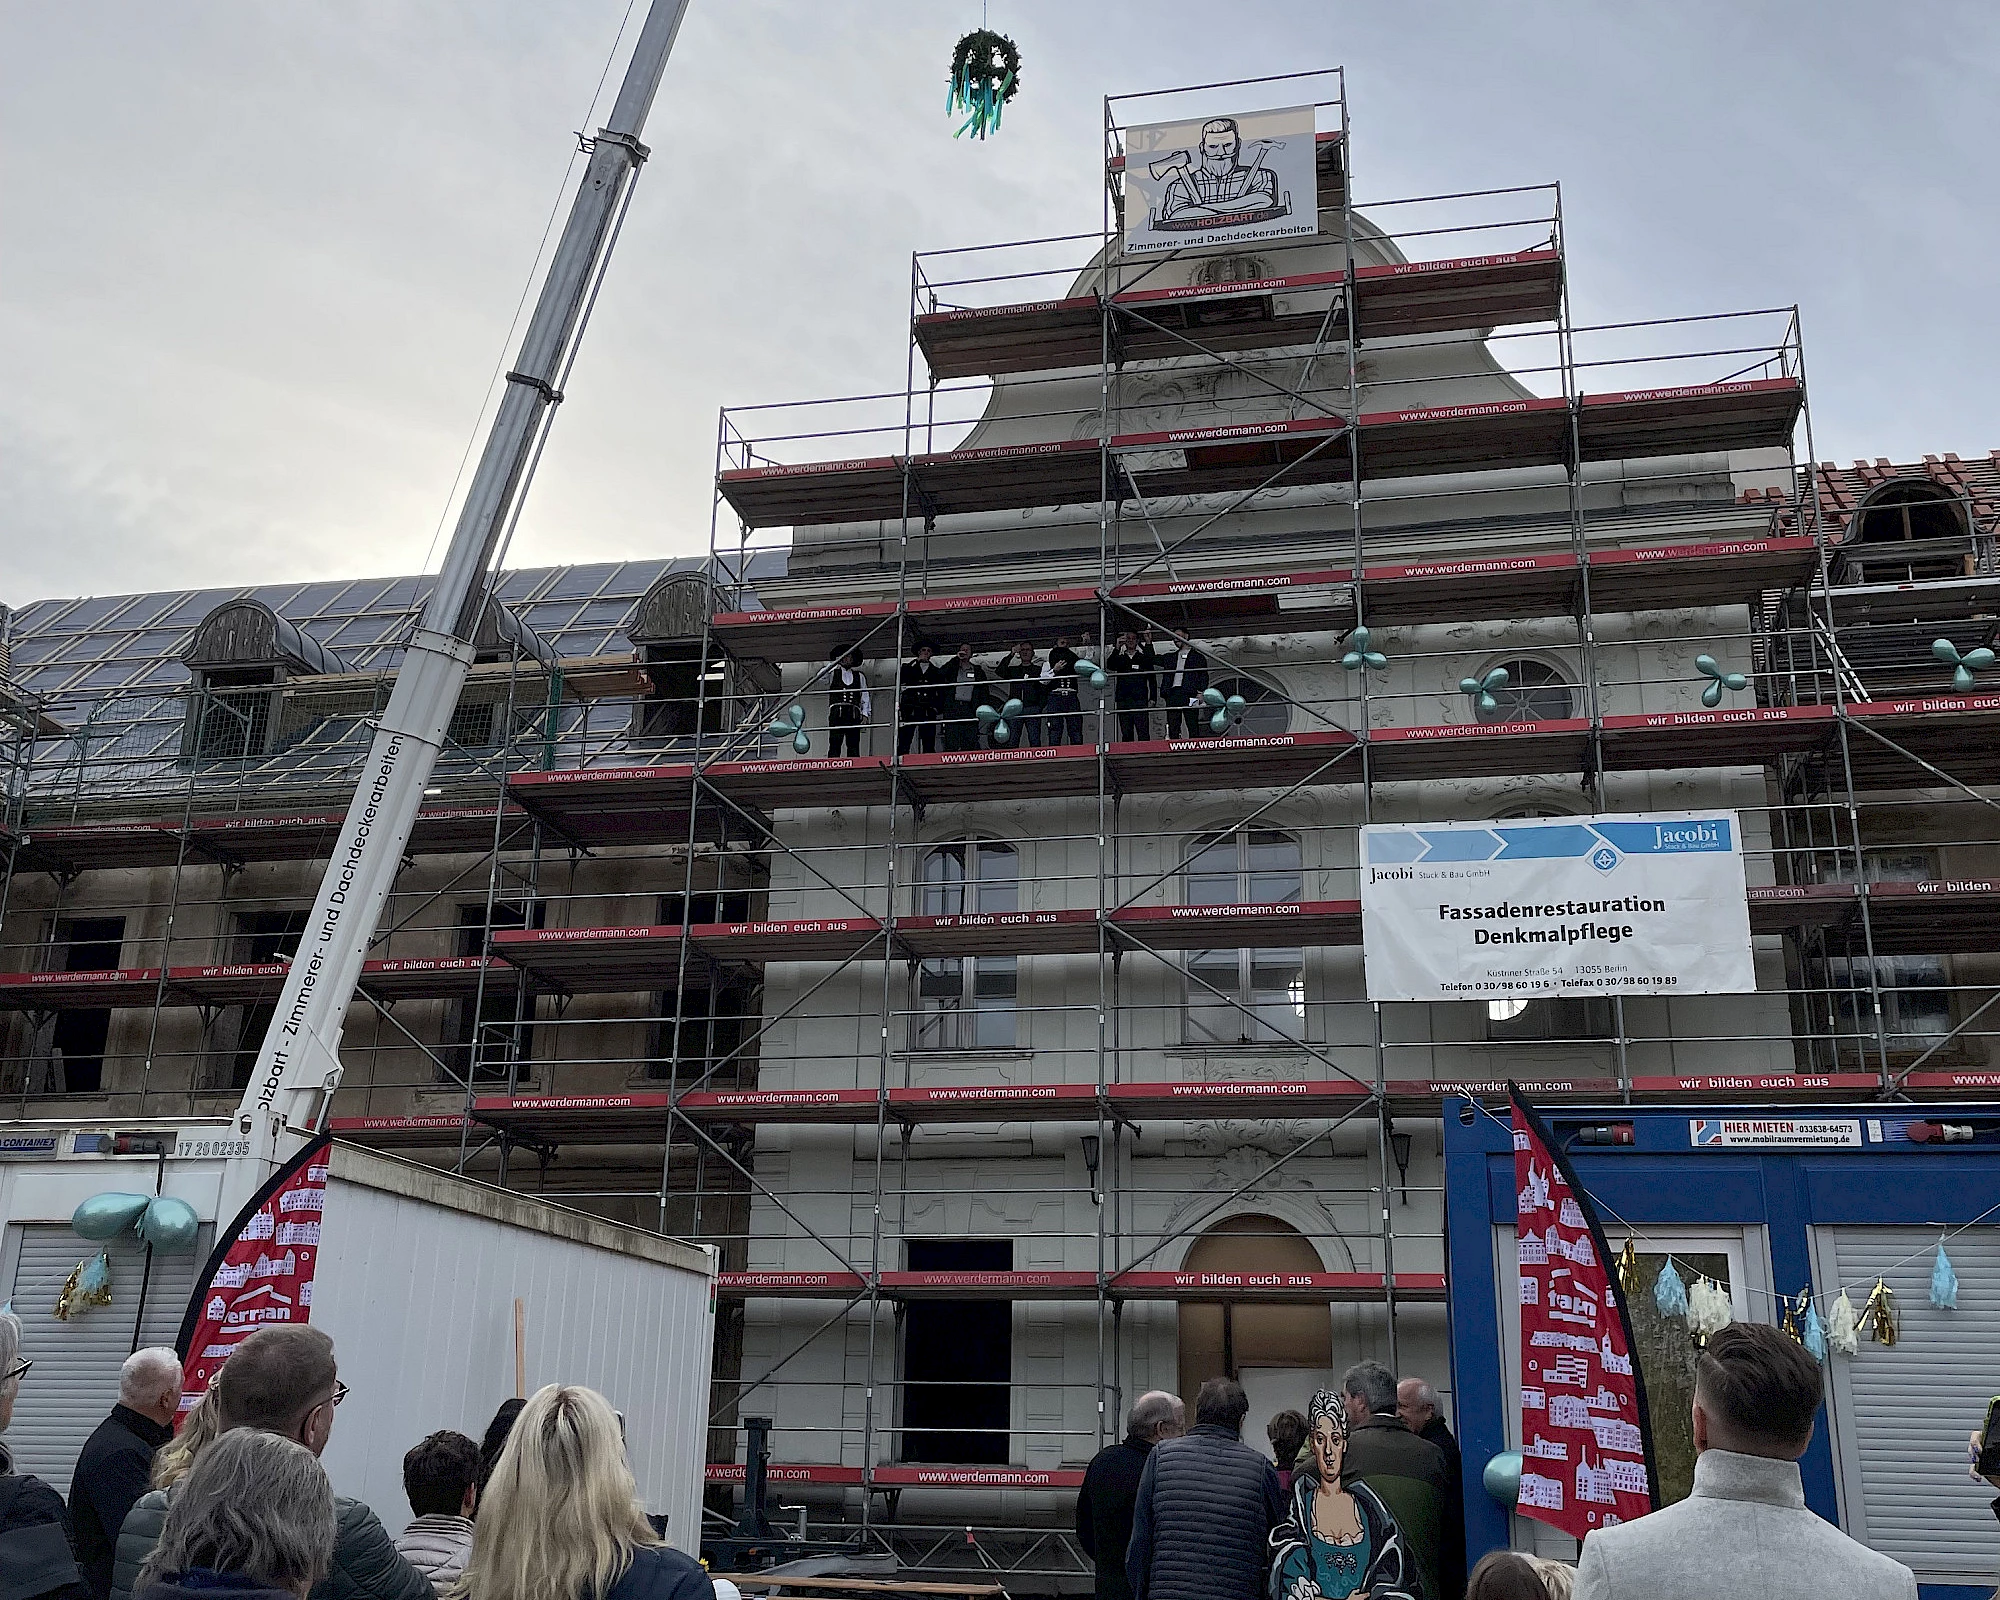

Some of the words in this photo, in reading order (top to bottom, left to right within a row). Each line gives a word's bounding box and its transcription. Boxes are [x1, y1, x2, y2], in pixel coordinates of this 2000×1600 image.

[1127, 239, 1181, 252] Zimmerer-
[1184, 237, 1204, 247] und
[1207, 225, 1313, 243] Dachdeckerarbeiten
[1394, 264, 1412, 275] wir
[1418, 261, 1454, 273] bilden
[1460, 257, 1490, 269] euch
[1496, 255, 1517, 265] aus
[1168, 278, 1286, 297] www.werdermann.com
[949, 302, 1057, 320] www.werdermann.com
[1623, 381, 1752, 401] www.werdermann.com
[1399, 402, 1527, 421] www.werdermann.com
[1168, 425, 1287, 443] www.werdermann.com
[760, 459, 867, 477] www.werdermann.com
[1404, 558, 1536, 576] www.werdermann.com
[1169, 575, 1291, 593] www.werdermann.com
[945, 592, 1058, 609] www.werdermann.com
[749, 605, 862, 622] www.werdermann.com
[1893, 702, 1914, 713] wir
[1921, 699, 1966, 711] bilden
[1646, 716, 1667, 727] wir
[1673, 713, 1716, 725] bilden
[1722, 711, 1754, 722] euch
[1762, 709, 1788, 720] aus
[1405, 722, 1536, 739] www.werdermann.com
[1169, 734, 1294, 751] www.werdermann.com
[941, 747, 1057, 764] www.werdermann.com
[741, 757, 853, 772] www.werdermann.com
[547, 767, 656, 782] www.werdermann.com
[330, 734, 404, 905] Dachdeckerarbeiten
[1653, 823, 1719, 850] Jacobi
[1369, 866, 1414, 885] Jacobi
[1419, 871, 1438, 879] Stuck
[1441, 871, 1448, 879] &
[1450, 871, 1464, 879] Bau
[1466, 869, 1490, 878] GmbH
[1916, 882, 1939, 894] wir
[1946, 880, 1991, 893] bilden
[1171, 903, 1300, 918] www.werdermann.com
[1438, 894, 1666, 921] Fassadenrestauration
[321, 908, 341, 942] und
[729, 923, 748, 935] wir
[753, 922, 788, 933] bilden
[793, 921, 821, 932] euch
[827, 921, 848, 931] aus
[934, 915, 954, 927] wir
[958, 913, 995, 926] bilden
[1000, 912, 1030, 924] euch
[1035, 913, 1057, 923] aus
[538, 926, 649, 941] www.werdermann.com
[1473, 921, 1633, 947] Denkmalpflege
[202, 967, 219, 977] wir
[222, 966, 253, 977] bilden
[257, 964, 284, 975] euch
[382, 962, 399, 972] wir
[403, 960, 435, 971] bilden
[439, 959, 465, 969] euch
[1524, 967, 1551, 977] Straße
[1553, 967, 1564, 976] 54
[1575, 966, 1603, 976] 13055
[1604, 964, 1628, 974] Berlin
[282, 947, 323, 1037] Zimmerer-
[1440, 981, 1473, 993] Telefon
[1475, 982, 1482, 991] 0
[1483, 981, 1514, 991] 30/98
[1515, 980, 1528, 990] 60
[1530, 980, 1541, 989] 19
[1543, 980, 1550, 988] 6
[1561, 978, 1595, 989] Telefax
[1596, 979, 1603, 988] 0
[1605, 977, 1636, 988] 30/98
[1637, 977, 1650, 986] 60
[1651, 976, 1663, 986] 19
[1665, 975, 1678, 985] 89
[258, 1051, 288, 1111] olzbart
[1429, 1079, 1573, 1093] www.werderann.com
[1679, 1079, 1701, 1090] wir
[1708, 1077, 1752, 1089] bilden
[1760, 1077, 1795, 1088] euch
[1803, 1076, 1829, 1087] aus
[716, 1092, 840, 1105] www.werdermann.com
[928, 1086, 1056, 1100] www.werdermann.com
[1172, 1083, 1307, 1097] www.werdermann.com
[512, 1096, 631, 1110] www.werdermann.com
[1724, 1121, 1750, 1133] HIER
[1752, 1120, 1795, 1133] MIETEN
[3, 1138, 56, 1148] CONTAINEX
[178, 1142, 192, 1157] 17
[212, 1140, 250, 1156] 02335
[1729, 1135, 1851, 1146] www.mobilraumvermietung.de
[922, 1273, 1051, 1286] www.werdermann.com
[1174, 1274, 1195, 1286] wir
[1201, 1273, 1241, 1286] bilden
[1248, 1273, 1282, 1286] euch
[1287, 1275, 1313, 1286] aus
[917, 1470, 1049, 1484] www.werdermann.com
